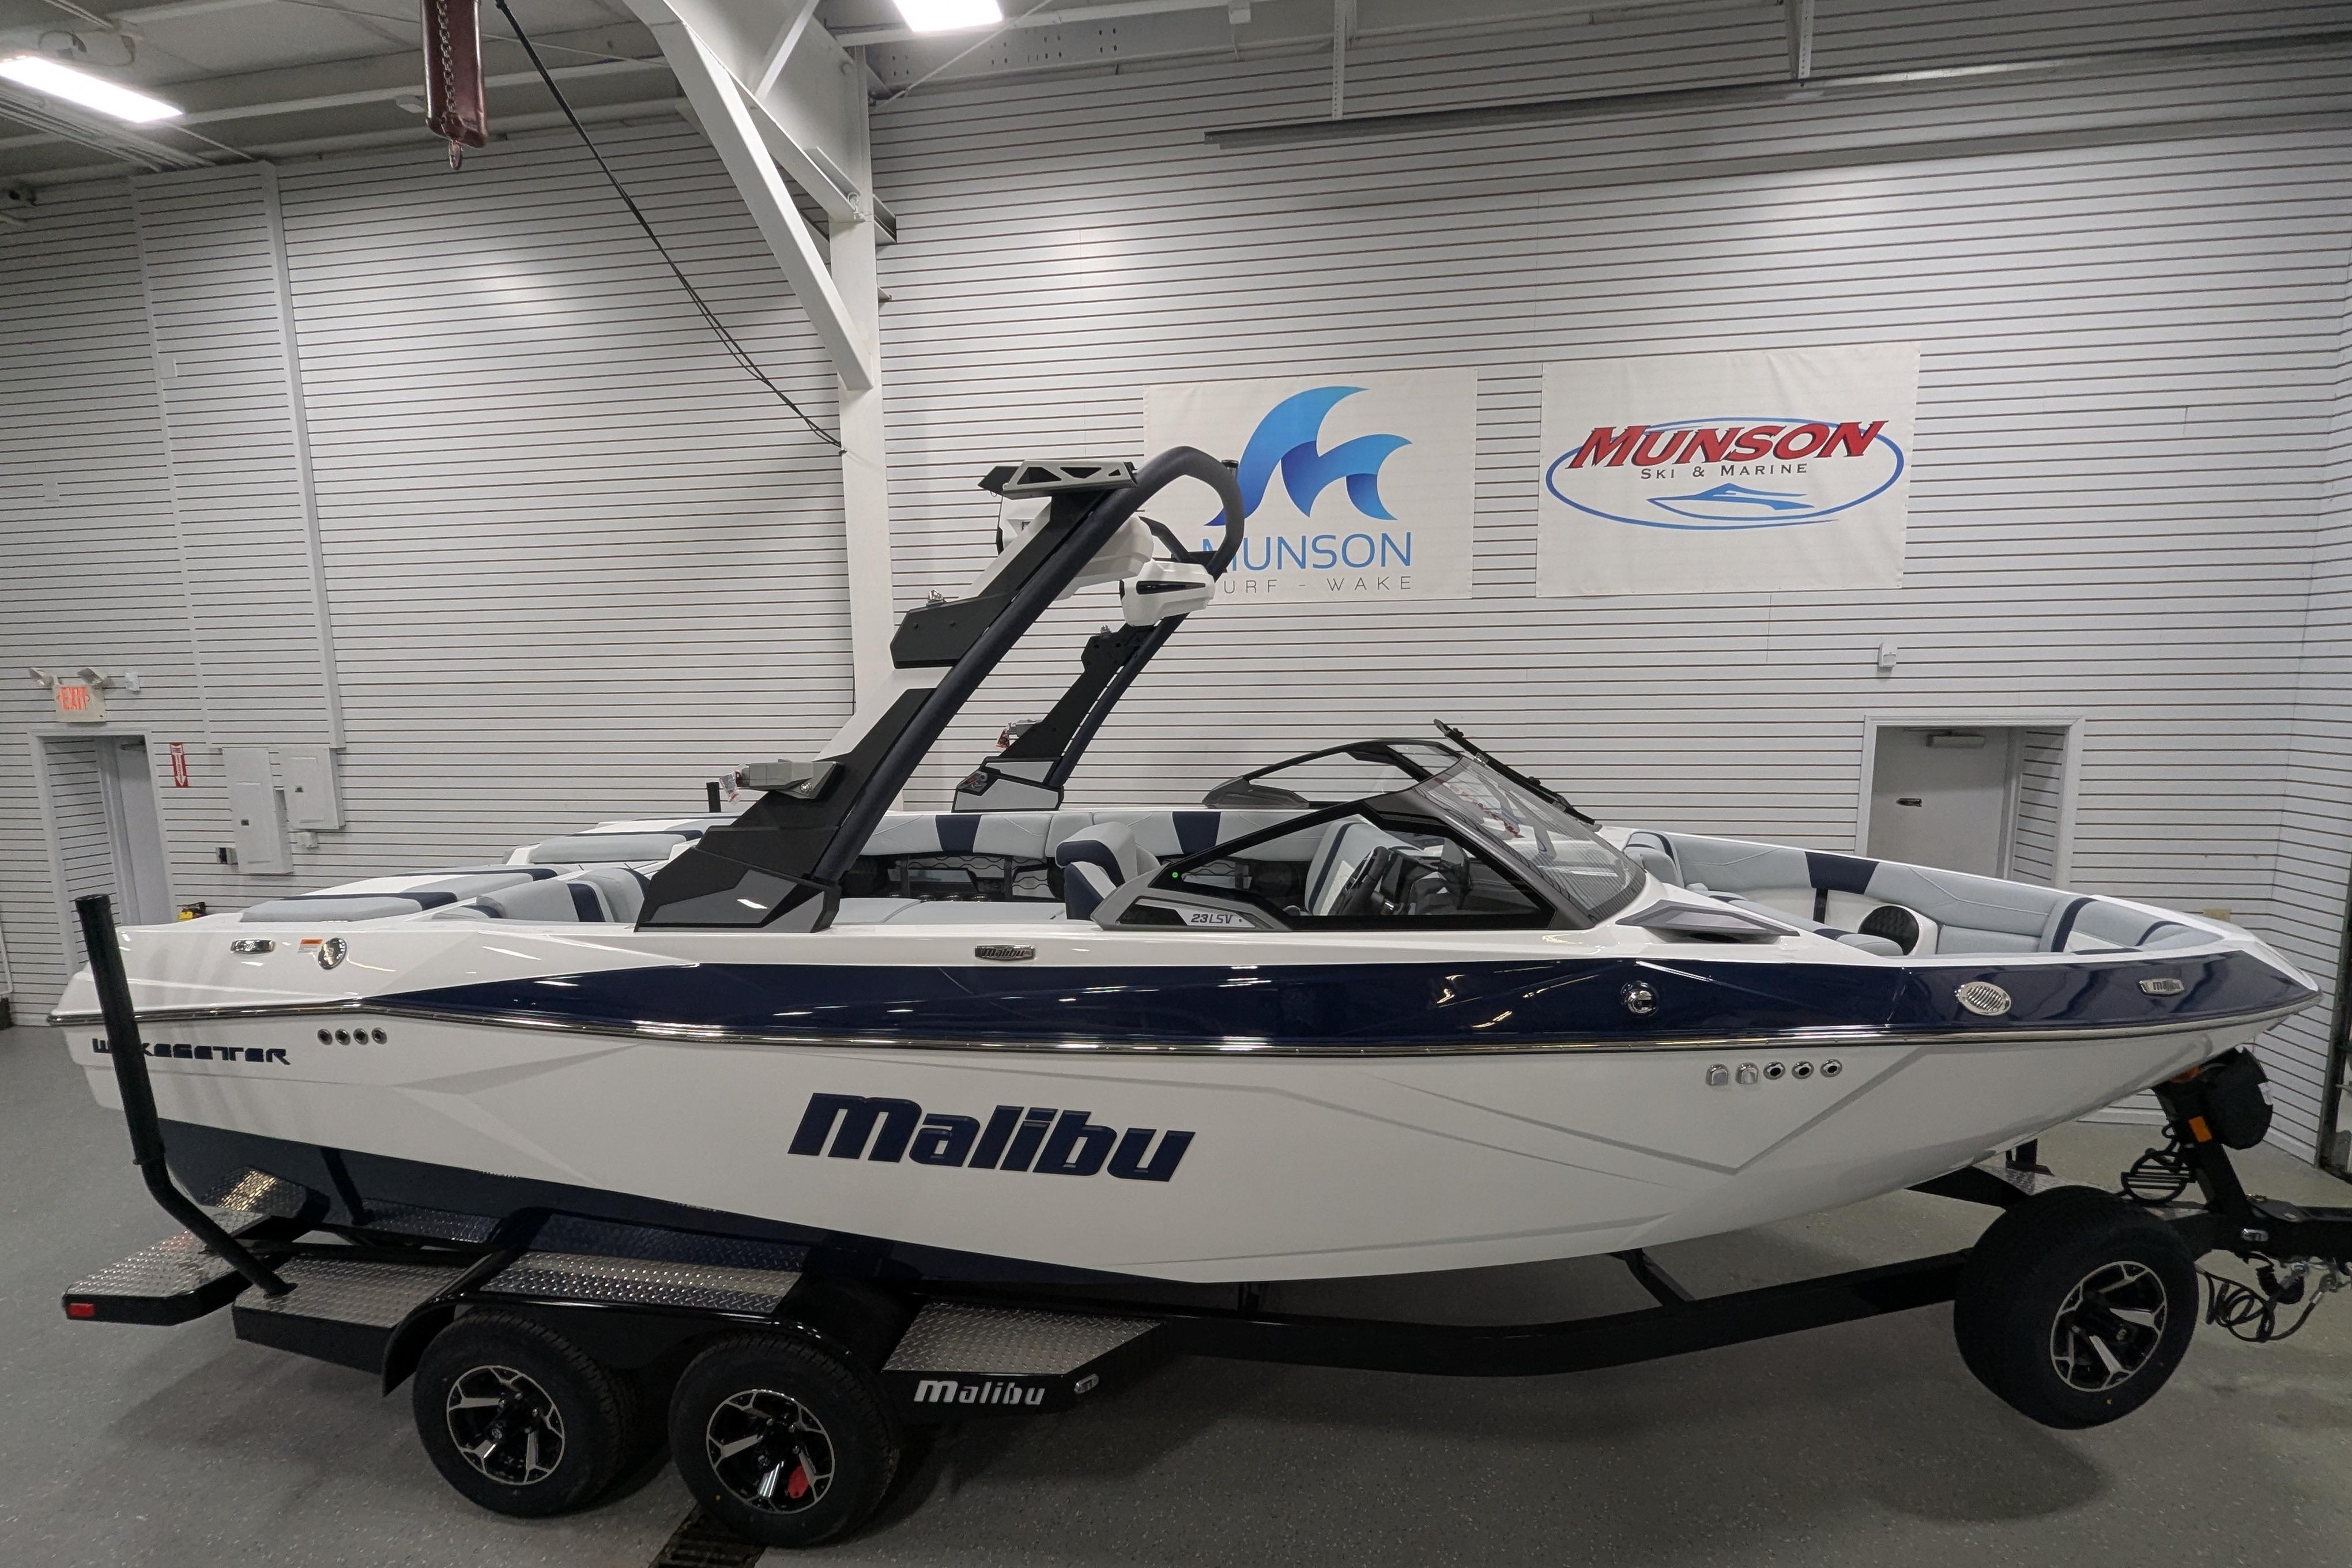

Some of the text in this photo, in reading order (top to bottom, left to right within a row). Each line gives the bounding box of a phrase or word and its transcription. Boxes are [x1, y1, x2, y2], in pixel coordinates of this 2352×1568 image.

[1565, 420, 1889, 469] MUNSON
[1693, 466, 1705, 477] &
[1224, 579, 1277, 594] URF
[1326, 576, 1411, 591] WAKE
[91, 1038, 291, 1065] WKESETTER
[787, 1092, 1196, 1182] Malibu
[914, 1380, 1045, 1405] Malibu
